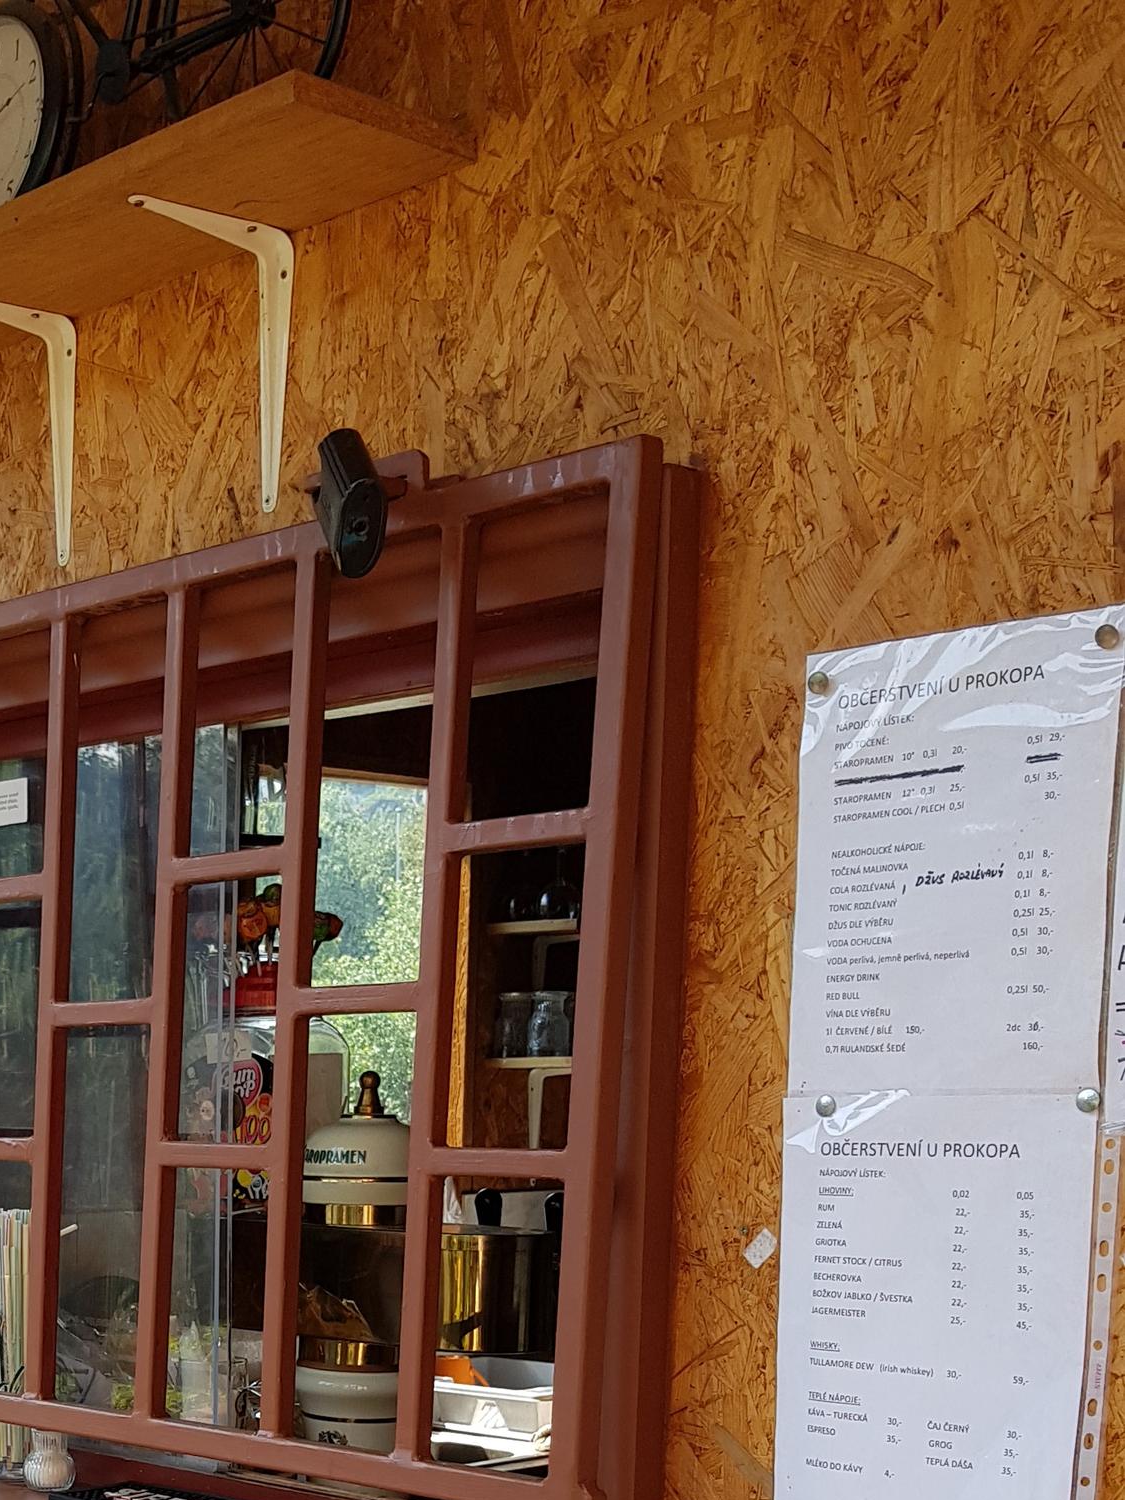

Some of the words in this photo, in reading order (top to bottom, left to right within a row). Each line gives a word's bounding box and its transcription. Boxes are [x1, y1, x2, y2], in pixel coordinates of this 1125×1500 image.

[29, 59, 36, 84] 2
[838, 675, 944, 709] OBČERSTVENÍ
[949, 677, 960, 693] U
[965, 665, 1044, 690] PROKOPA
[834, 792, 892, 805] STAROPRAMEN
[833, 810, 890, 823] STAROPRAMEN
[892, 806, 913, 817] COOL
[921, 804, 945, 813] PLECH
[831, 866, 861, 877] TOČENÁ
[863, 863, 908, 874] MALINOVKA
[830, 886, 849, 895] COLA
[851, 882, 896, 893] ROZLÉVANÁ
[829, 903, 852, 912] TONIC
[828, 920, 848, 930] DŽUS
[849, 920, 862, 929] DLE
[864, 918, 893, 927] VÝBĚRU
[827, 939, 848, 948] VODA
[827, 956, 848, 965] VODA
[877, 953, 902, 964] jemně
[934, 950, 970, 961] neperlivá
[826, 975, 855, 983] ENERGY
[857, 973, 880, 982] DRINK
[826, 992, 840, 1000] RED
[842, 992, 859, 1000] BULL
[826, 1009, 843, 1018] VÍNA
[845, 1009, 859, 1018] DLE
[861, 1008, 891, 1017] VÝBĚRU
[835, 1025, 869, 1036] ČERVENÉ
[876, 1025, 892, 1035] BÍLÉ
[840, 1043, 884, 1053] RULANDSKÉ
[886, 1042, 906, 1052] ŠEDÉ
[820, 1138, 923, 1157] OBČERSTVENÍ
[927, 1144, 937, 1157] U
[943, 1144, 1020, 1159] PROKOPA
[819, 1168, 857, 1177] NÁPOJOVÝ
[952, 1190, 970, 1199] 0,02
[1017, 1191, 1034, 1201] 0,05
[818, 1203, 835, 1212] RUM
[817, 1220, 843, 1230] ZELENÁ
[815, 1238, 847, 1248] GRIOTKA
[814, 1255, 841, 1265] FERNET
[843, 1256, 867, 1266] STOCK
[875, 1258, 903, 1268] CITRUS
[813, 1272, 862, 1283] BECHEROVKA
[812, 1289, 842, 1299] BOŽKOV
[844, 1291, 872, 1301] JABLKO
[879, 1292, 913, 1304] ŠVESTKA
[810, 1357, 854, 1370] TULLAMORE
[856, 1362, 874, 1371] DEW
[808, 1391, 827, 1401] TEPLÉ
[808, 1408, 825, 1418] KÁVA
[833, 1411, 868, 1422] TURECKÁ
[927, 1420, 942, 1431] ČAJ
[943, 1421, 970, 1434] ČERNÝ
[807, 1425, 836, 1436] ESPRESO
[928, 1440, 953, 1450] GROG
[805, 1457, 829, 1469] MLÉKO
[830, 1462, 842, 1470] DO
[843, 1463, 863, 1475] KÁVY
[925, 1457, 950, 1467] TEPLÁ
[951, 1459, 973, 1470] DÁŠA
